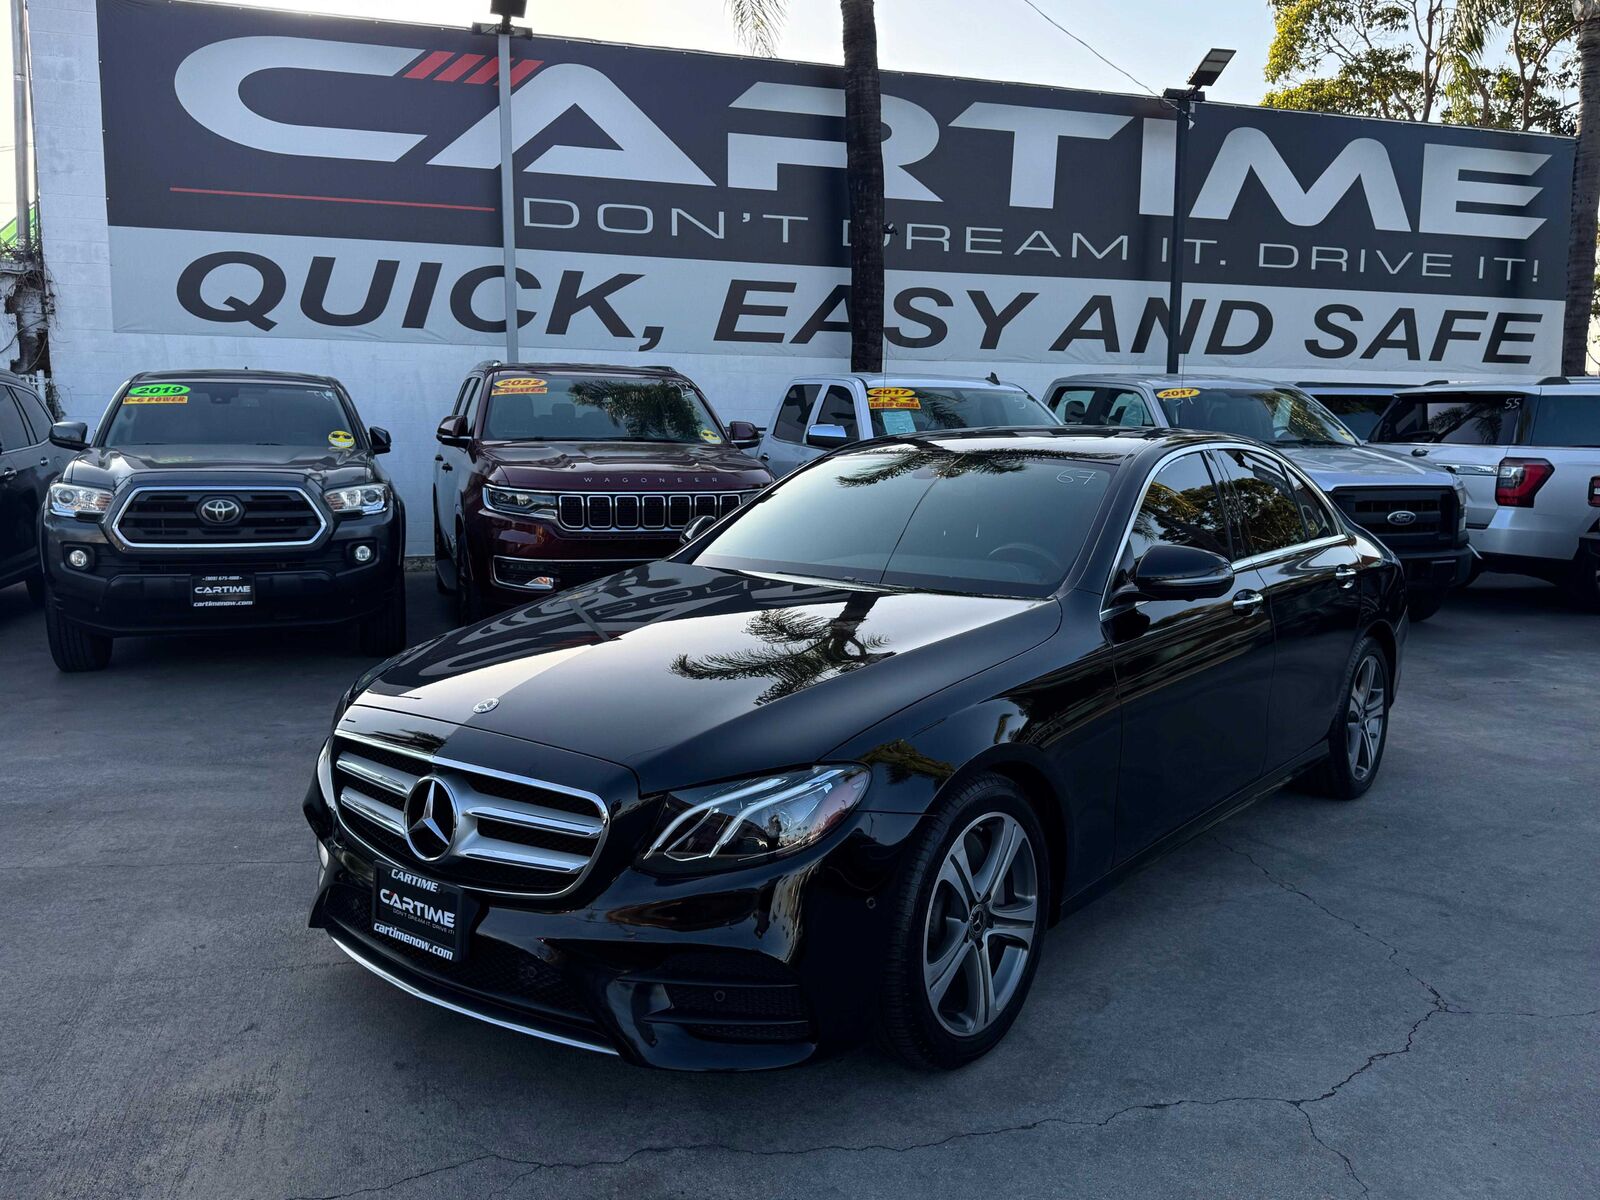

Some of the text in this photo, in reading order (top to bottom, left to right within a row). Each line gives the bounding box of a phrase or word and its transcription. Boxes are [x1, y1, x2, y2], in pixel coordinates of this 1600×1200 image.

[174, 36, 1552, 240] CARTIME
[523, 197, 809, 243] DON'T
[1161, 237, 1227, 266] IT.
[1258, 242, 1454, 279] DRIVE
[1478, 256, 1540, 283] IT!
[176, 250, 1544, 365] QUICK, EASY AND SAFE
[136, 386, 184, 395] 2019
[500, 379, 543, 387] 2022
[1162, 389, 1195, 398] 2017
[1504, 397, 1522, 410] 55
[1056, 468, 1097, 486] 67
[194, 585, 252, 594] CARTIME
[193, 600, 254, 608] cartimenow.com
[391, 868, 439, 893] CARTIME
[380, 888, 456, 929] CARTIME
[373, 922, 454, 961] cartimenow.com
